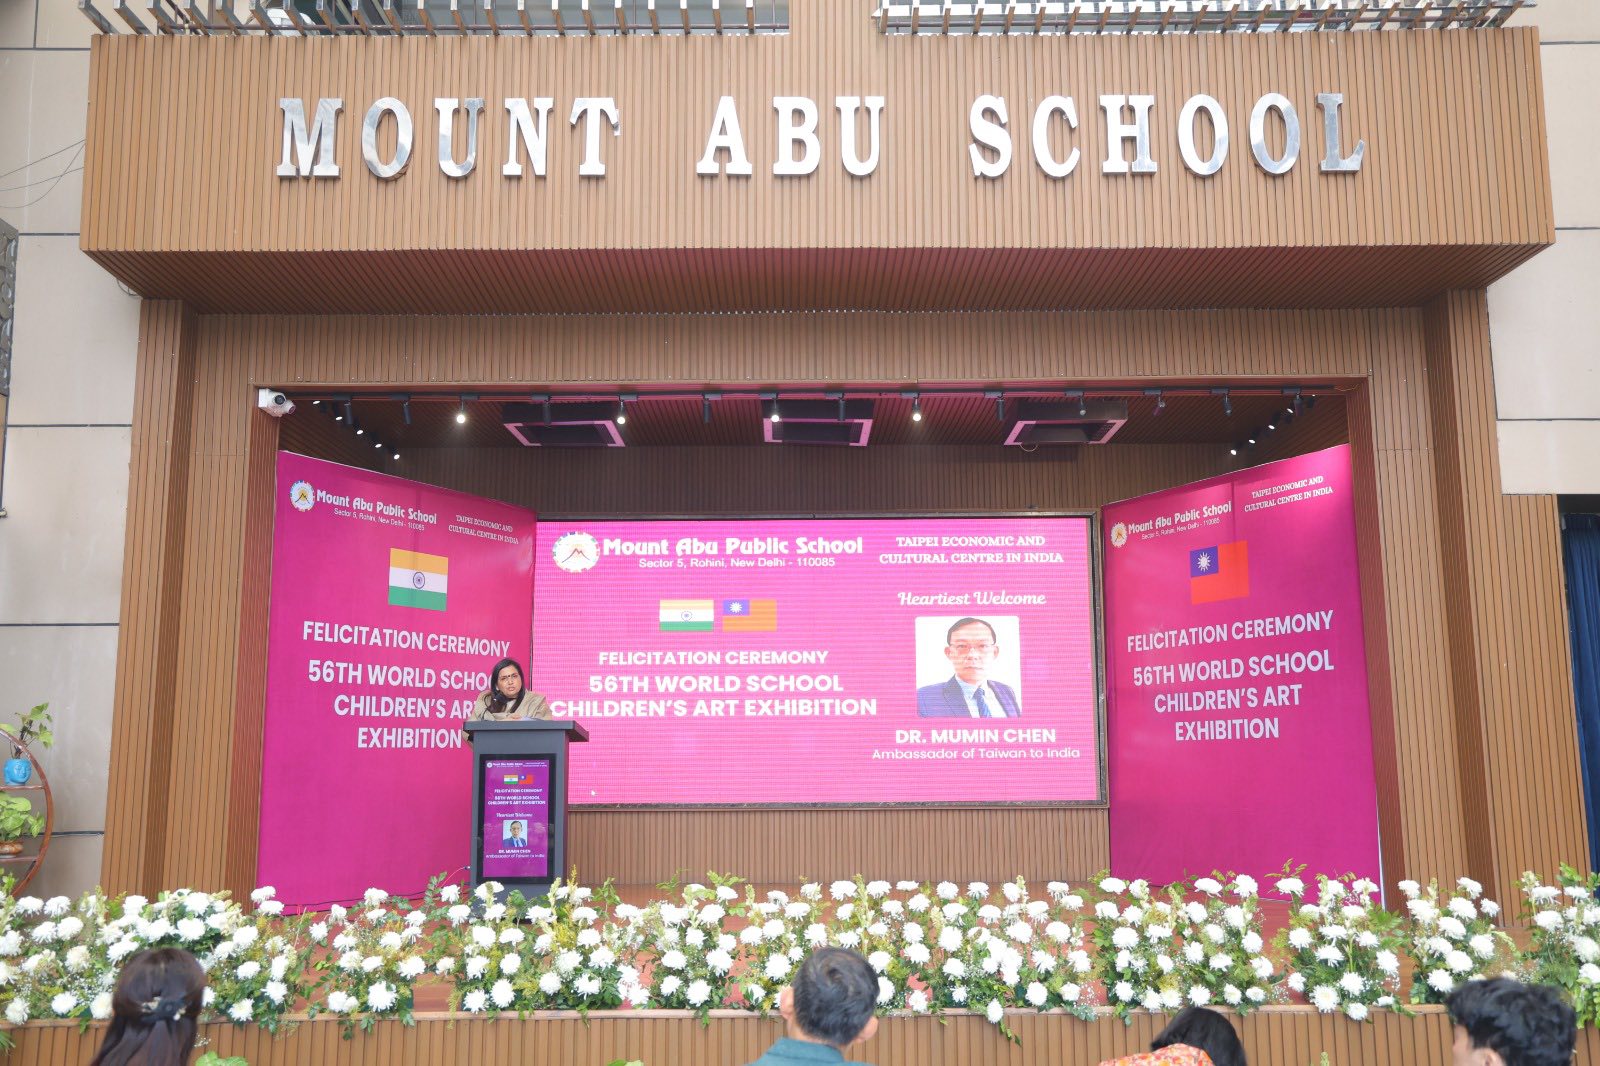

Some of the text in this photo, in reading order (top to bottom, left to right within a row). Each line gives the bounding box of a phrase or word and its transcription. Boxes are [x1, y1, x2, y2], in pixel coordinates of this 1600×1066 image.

[276, 92, 1365, 180] MOUNT ABU SCHOOL
[1252, 476, 1323, 498] TAIPEI ECONOMIC AND
[317, 489, 437, 524] Mount Abu Public School
[1244, 499, 1276, 512] CULTURAL
[1277, 493, 1303, 504] CENTRE
[1312, 486, 1333, 497] INDIA
[1128, 501, 1232, 534] Mount Abu Public School
[603, 536, 863, 556] Mount Abu Public School
[896, 536, 1045, 547] TAIPEI ECONOMIC AND
[639, 558, 673, 568] Sector
[677, 558, 687, 569] 5,
[690, 558, 727, 568] Rohini,
[731, 558, 755, 567] New
[758, 557, 786, 567] Delhi
[796, 558, 835, 567] 110085
[879, 553, 1064, 565] CULTURAL CENTRE IN INDIA
[898, 590, 1047, 606] Heartiest Welcome
[303, 621, 510, 658] FELICITATION CEREMONY
[1127, 610, 1334, 653] FELICITATION CEREMONY
[599, 650, 828, 666] FELICITATION CEREMONY
[1133, 649, 1334, 686] 56TH WORLD SCHOOL
[308, 659, 491, 691] 56TH WORLD SCHO
[589, 674, 843, 693] 56TH WORLD SCHOOL
[334, 694, 476, 719] CHILDREN'S AR
[550, 698, 877, 718] CHILDREN'S ART EXHIBITION
[1154, 684, 1303, 713] CHILDREN'S ART
[357, 727, 462, 749] EXHIBITION
[895, 729, 1056, 744] DR. MUMIN CHEN
[1175, 718, 1279, 741] EXHIBITION
[873, 748, 1080, 760] Ambassador of Taiwan to India
